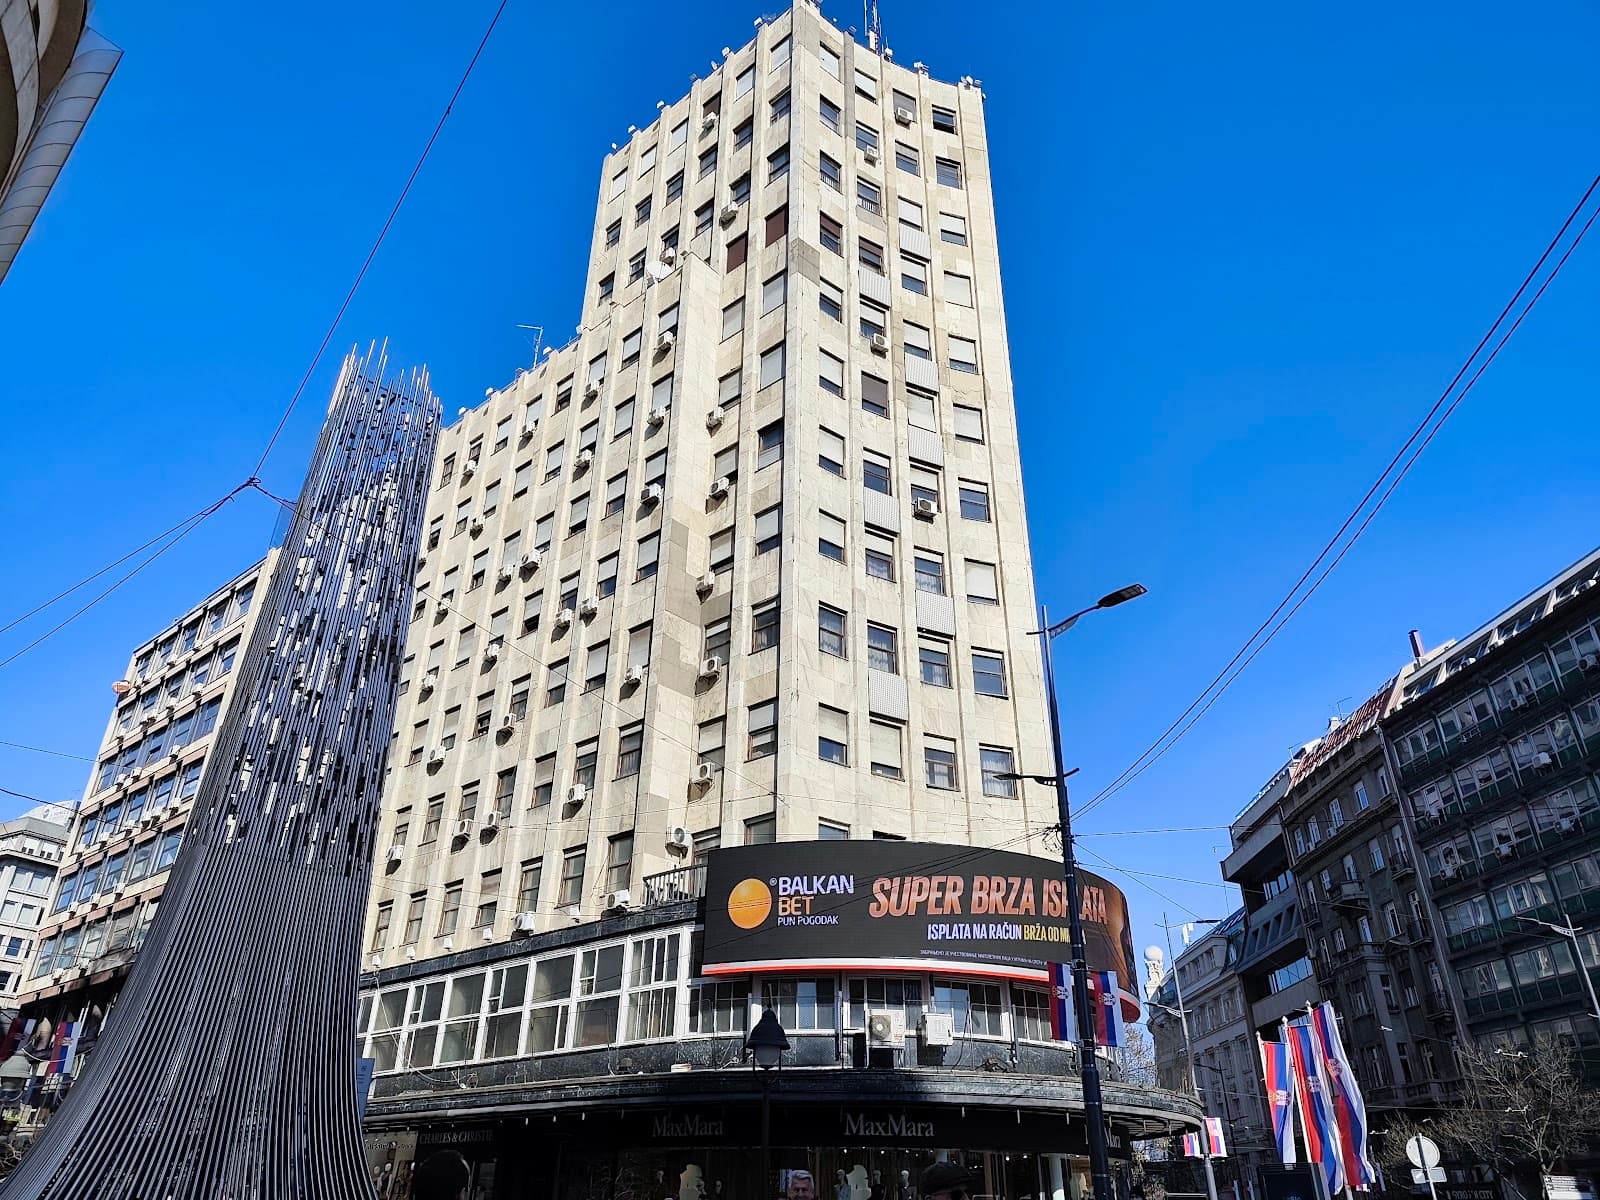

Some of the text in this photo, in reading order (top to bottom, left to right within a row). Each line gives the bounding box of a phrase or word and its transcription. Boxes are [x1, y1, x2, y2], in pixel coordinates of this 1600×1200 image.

[778, 875, 854, 895] BALKAN
[869, 874, 965, 918] SUPER
[971, 875, 1036, 916] BRZA
[778, 896, 815, 915] BET
[777, 915, 839, 926] PUN POGODAK
[927, 923, 970, 940] ISPLATA
[973, 924, 988, 940] NA
[989, 921, 1022, 941] RAČUN
[1023, 922, 1047, 942] BRŽA
[1048, 926, 1060, 943] OD
[651, 1113, 724, 1138] MaxMara
[844, 1113, 935, 1137] MaxMara
